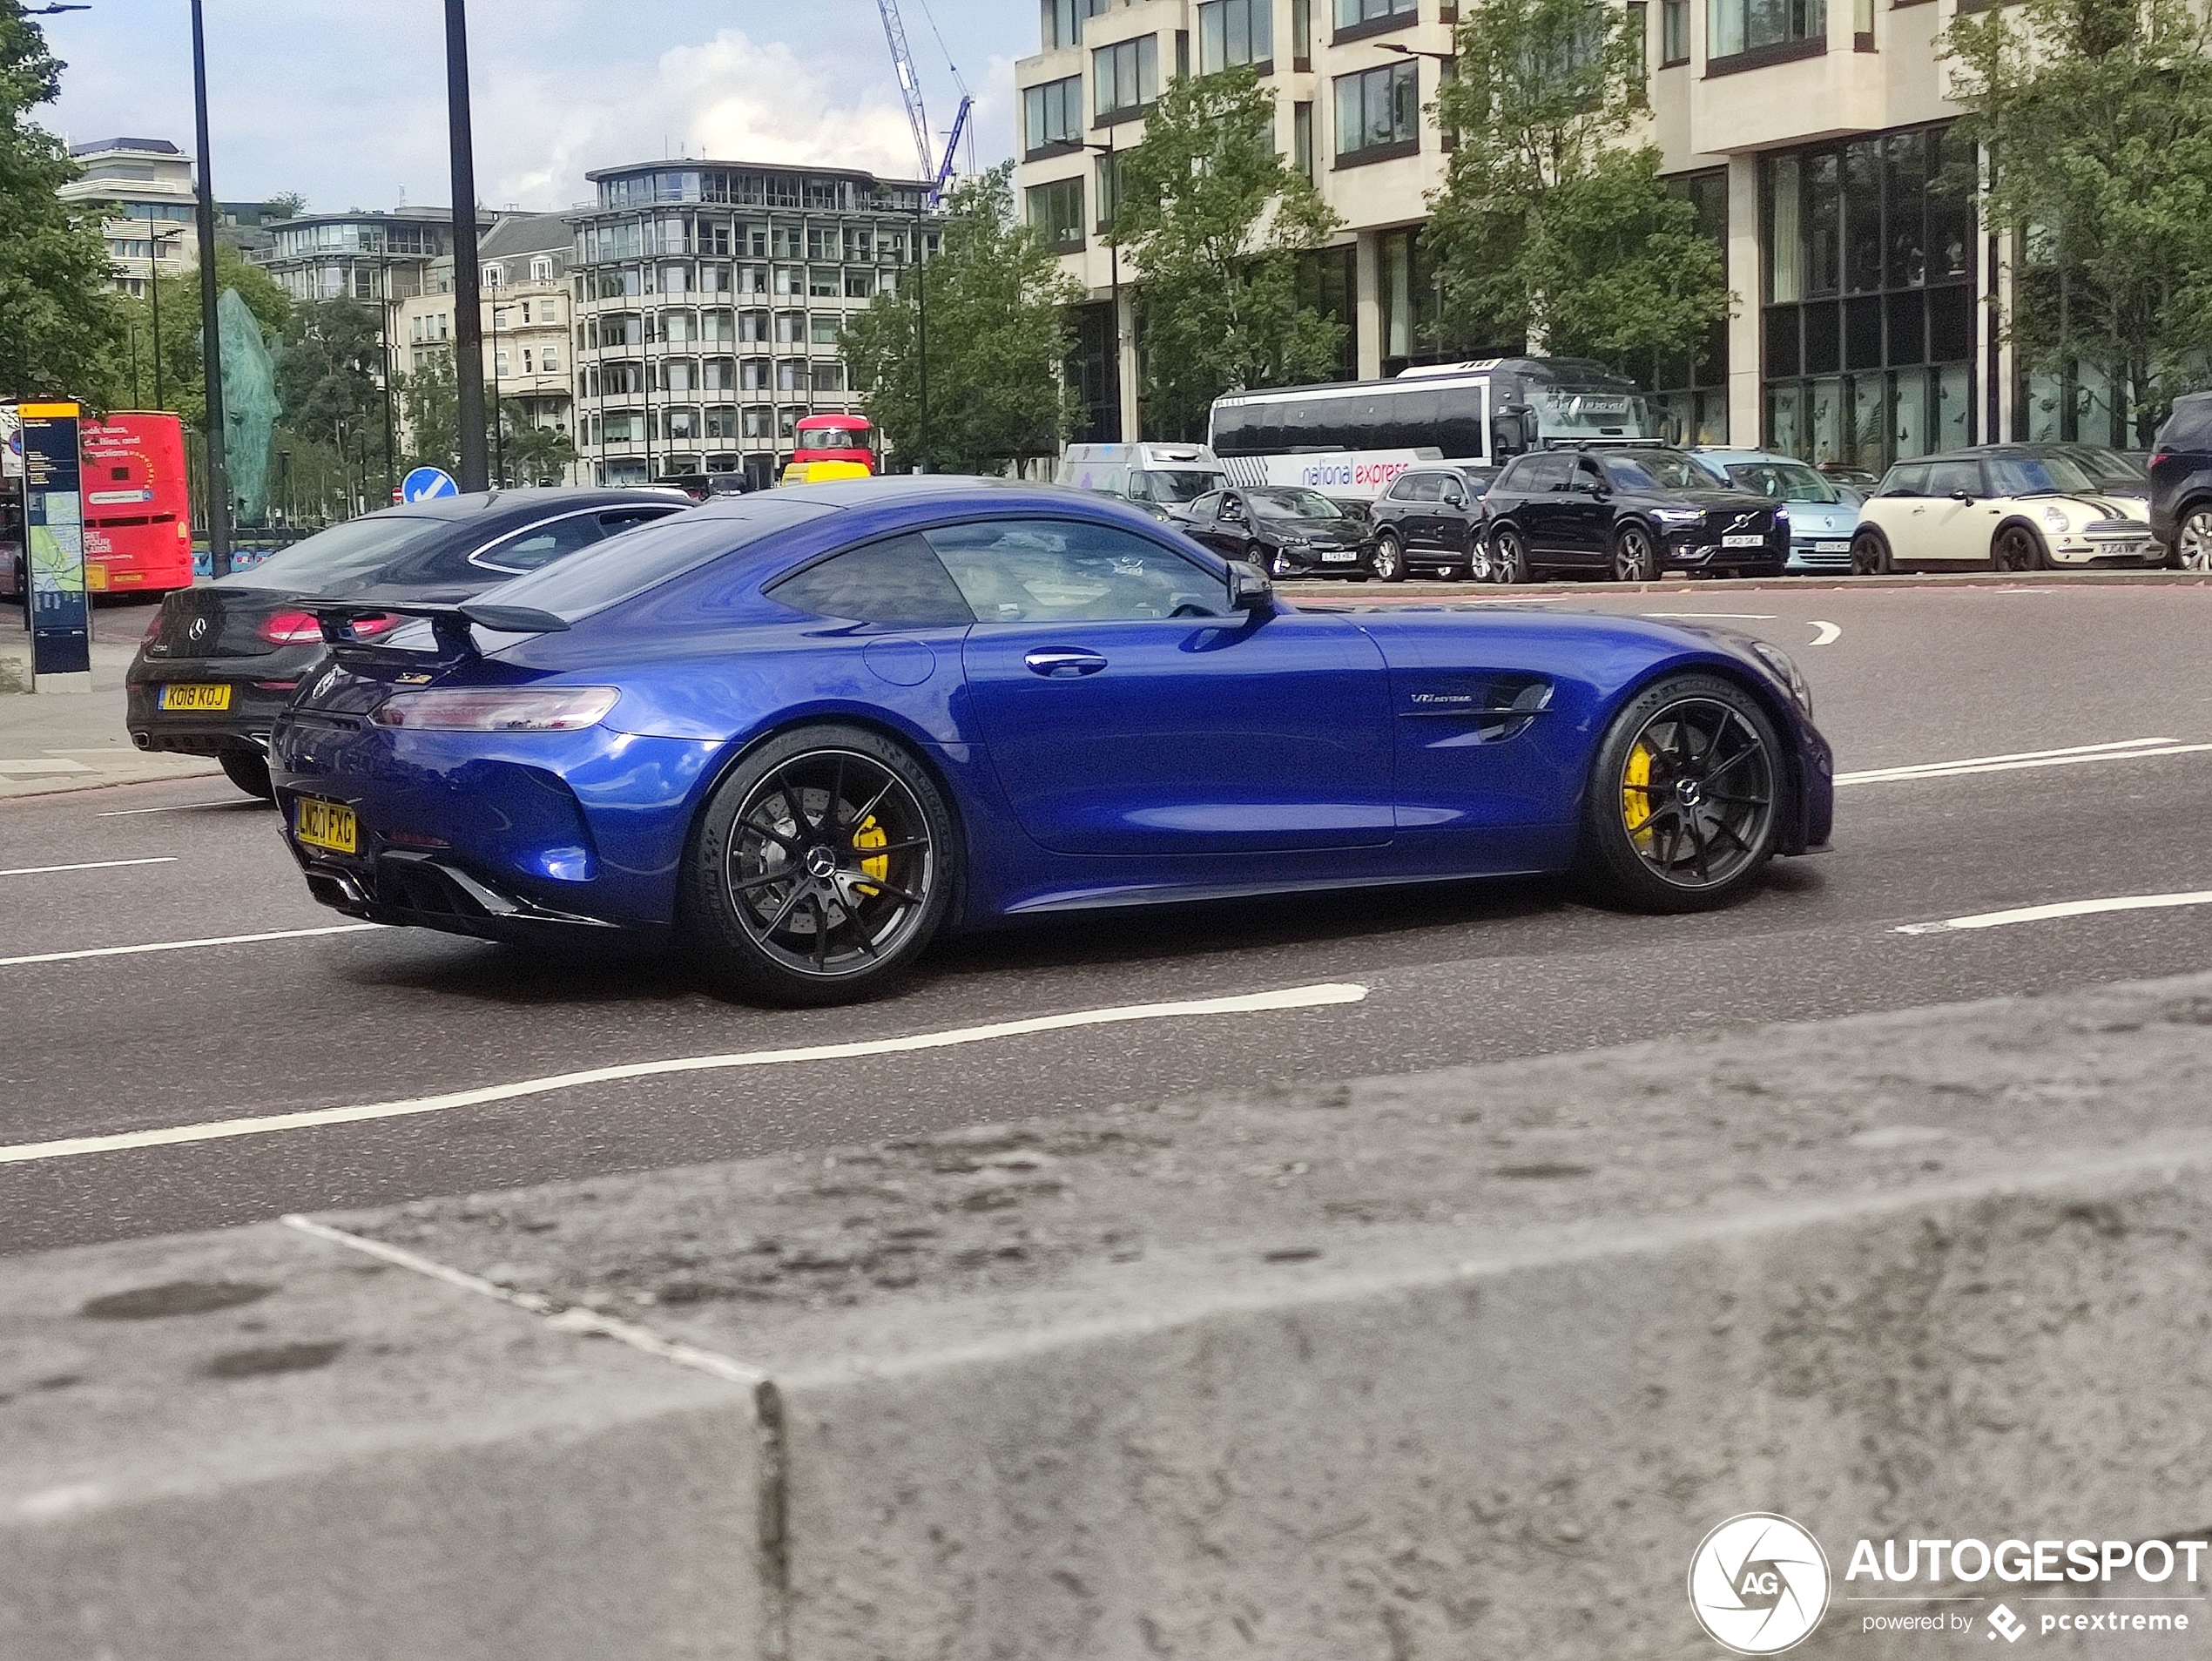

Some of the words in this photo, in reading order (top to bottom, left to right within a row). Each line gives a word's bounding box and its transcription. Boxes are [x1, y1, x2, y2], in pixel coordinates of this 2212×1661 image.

[1303, 457, 1352, 485] national
[168, 687, 196, 706] KO18
[328, 808, 352, 843] FXG
